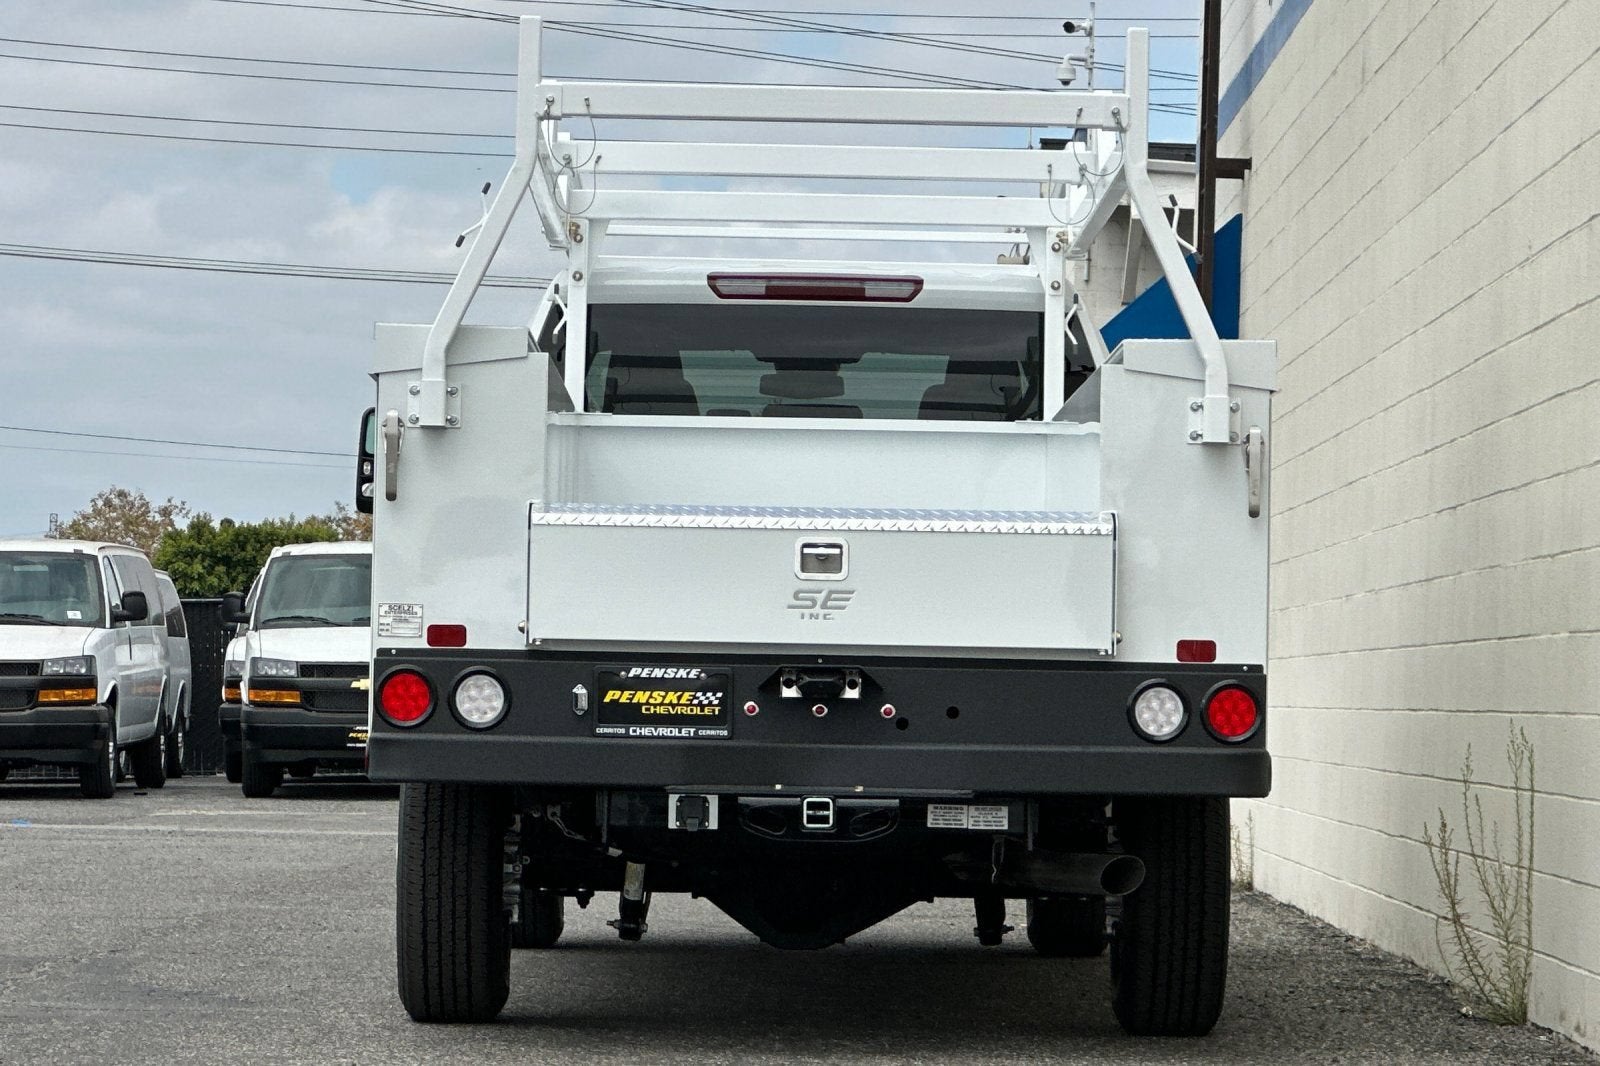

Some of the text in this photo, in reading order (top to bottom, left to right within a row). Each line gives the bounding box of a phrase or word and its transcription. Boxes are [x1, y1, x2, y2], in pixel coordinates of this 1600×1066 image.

[787, 589, 856, 610] SE
[627, 667, 701, 679] PENSKE
[603, 690, 695, 704] PENSKE
[641, 705, 721, 715] CHEVROLET
[629, 727, 696, 736] CHEVROLET
